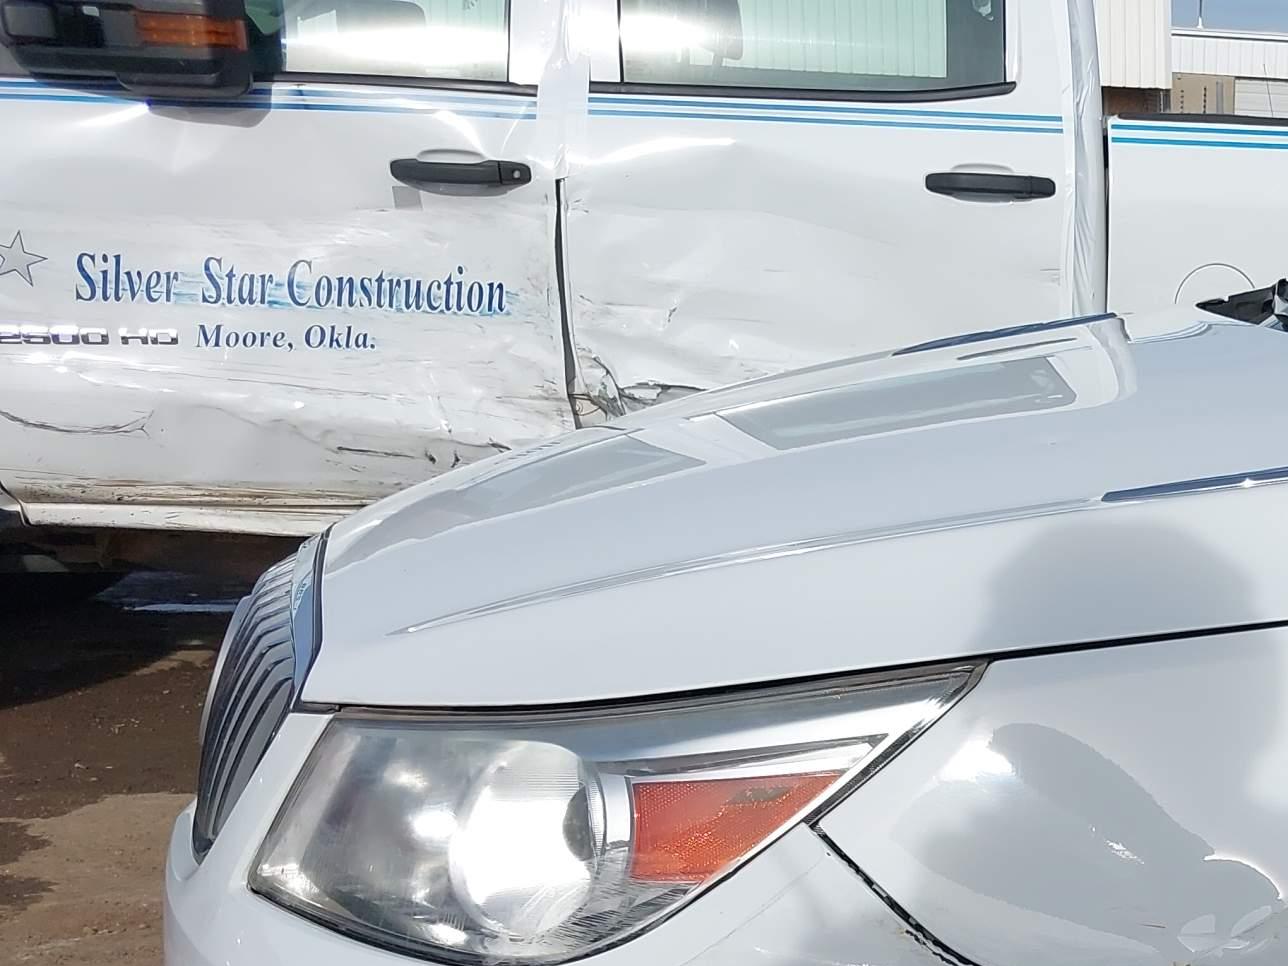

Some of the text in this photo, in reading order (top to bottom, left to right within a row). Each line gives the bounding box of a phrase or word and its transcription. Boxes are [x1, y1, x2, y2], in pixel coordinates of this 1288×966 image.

[75, 252, 507, 313] Silver Star Construction
[0, 325, 179, 345] 2500 HD
[195, 323, 376, 353] Moore, Okla.
